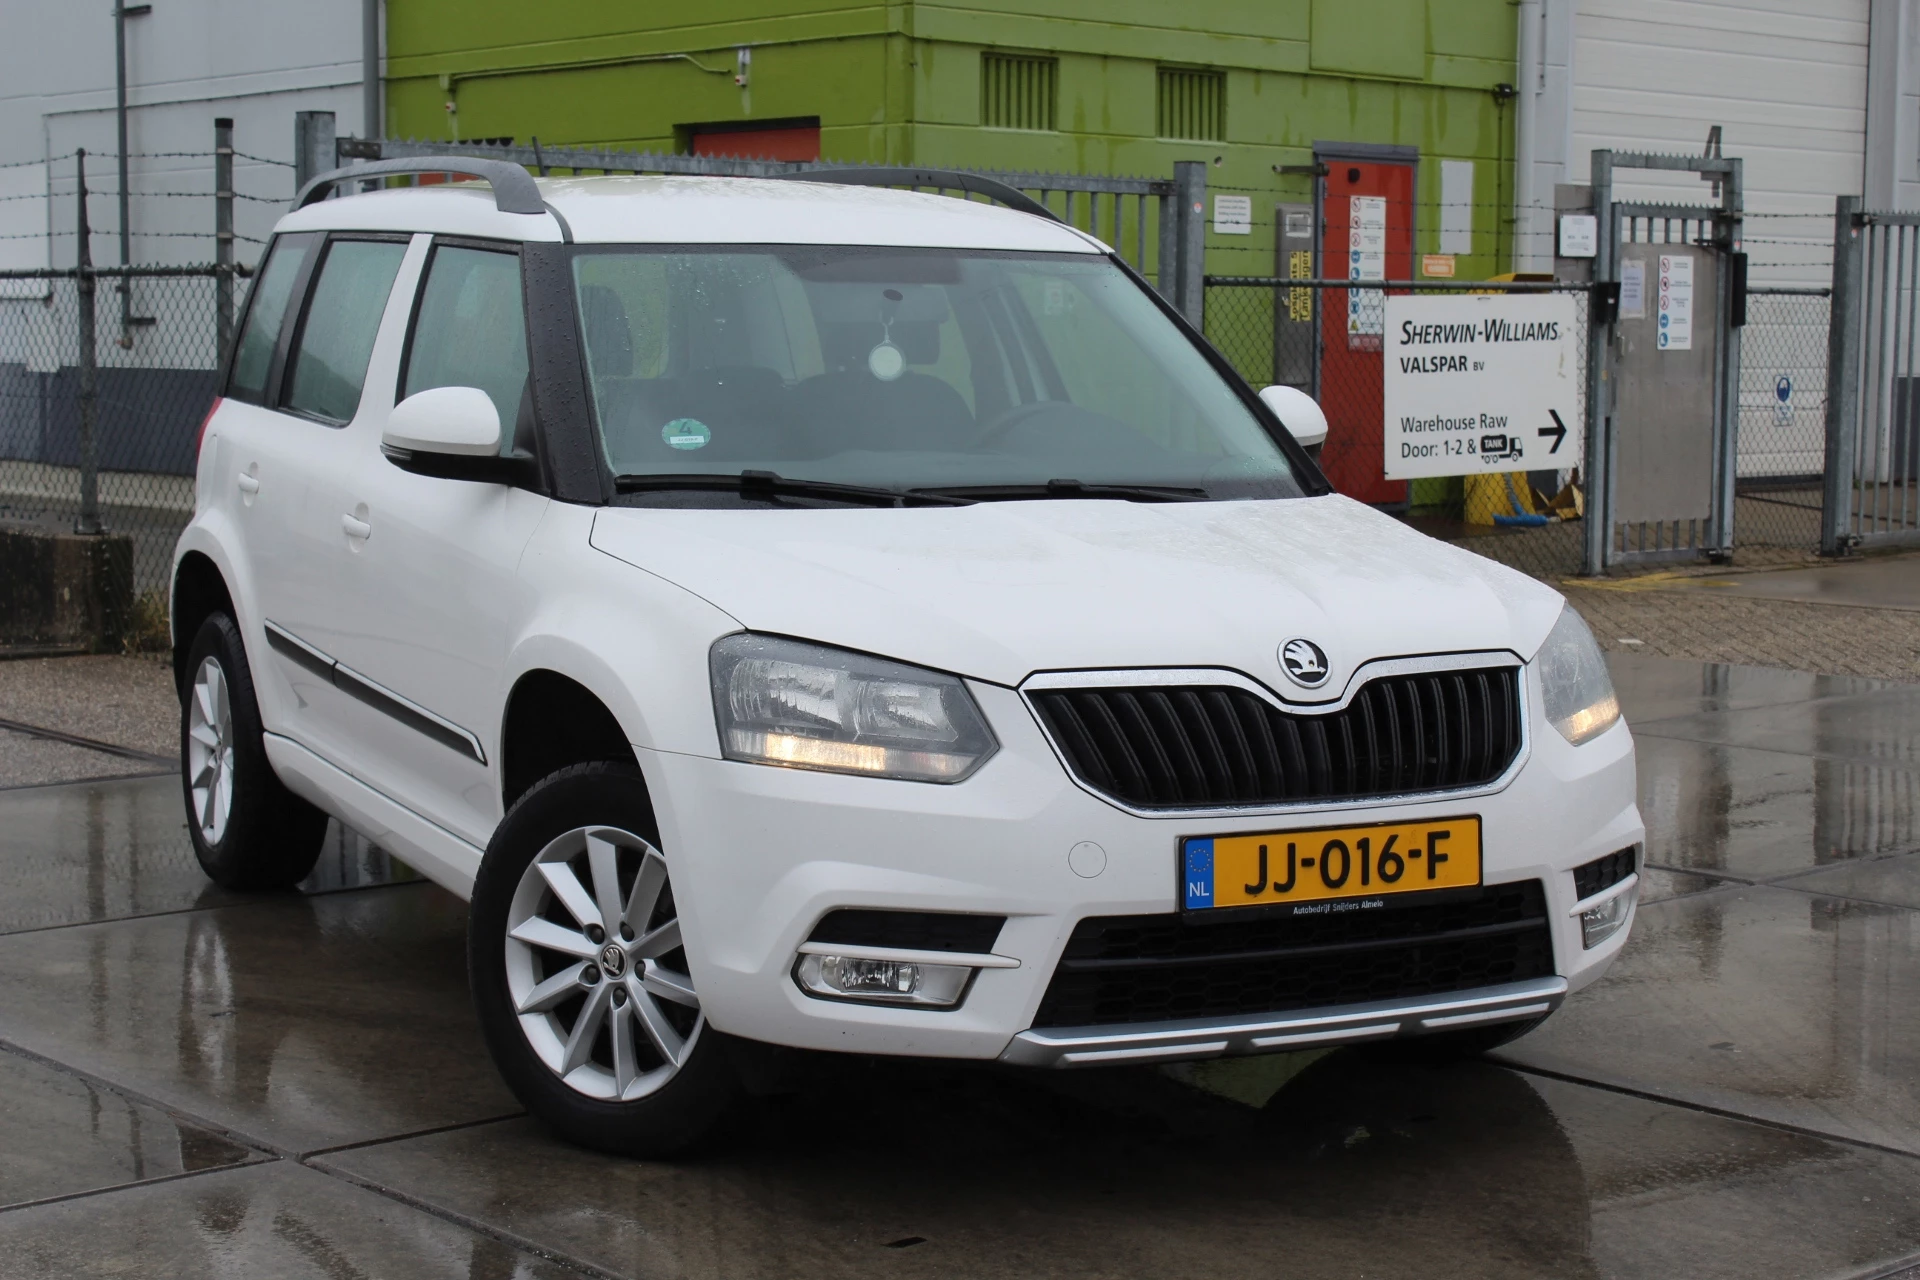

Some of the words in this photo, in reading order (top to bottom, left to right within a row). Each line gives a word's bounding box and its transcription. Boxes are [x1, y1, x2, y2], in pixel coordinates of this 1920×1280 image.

[1700, 125, 1722, 198] 4
[1301, 250, 1311, 318] Tankagen
[1400, 318, 1558, 345] SHERWIN-WILLIAMS
[1400, 355, 1468, 374] VALSPAR
[1473, 361, 1485, 372] BV
[679, 422, 692, 434] 4
[1401, 414, 1476, 433] Warehouse
[1480, 413, 1508, 429] Raw
[1401, 442, 1438, 459] Door:
[1443, 440, 1463, 456] 1-2
[1467, 439, 1476, 455] &
[1484, 438, 1504, 449] TANK
[1244, 830, 1451, 895] JJ-016-F
[1188, 881, 1210, 897] NL
[1293, 904, 1331, 915] Autobedrijf
[1333, 902, 1359, 912] Snijders
[1361, 900, 1384, 909] Almelo
